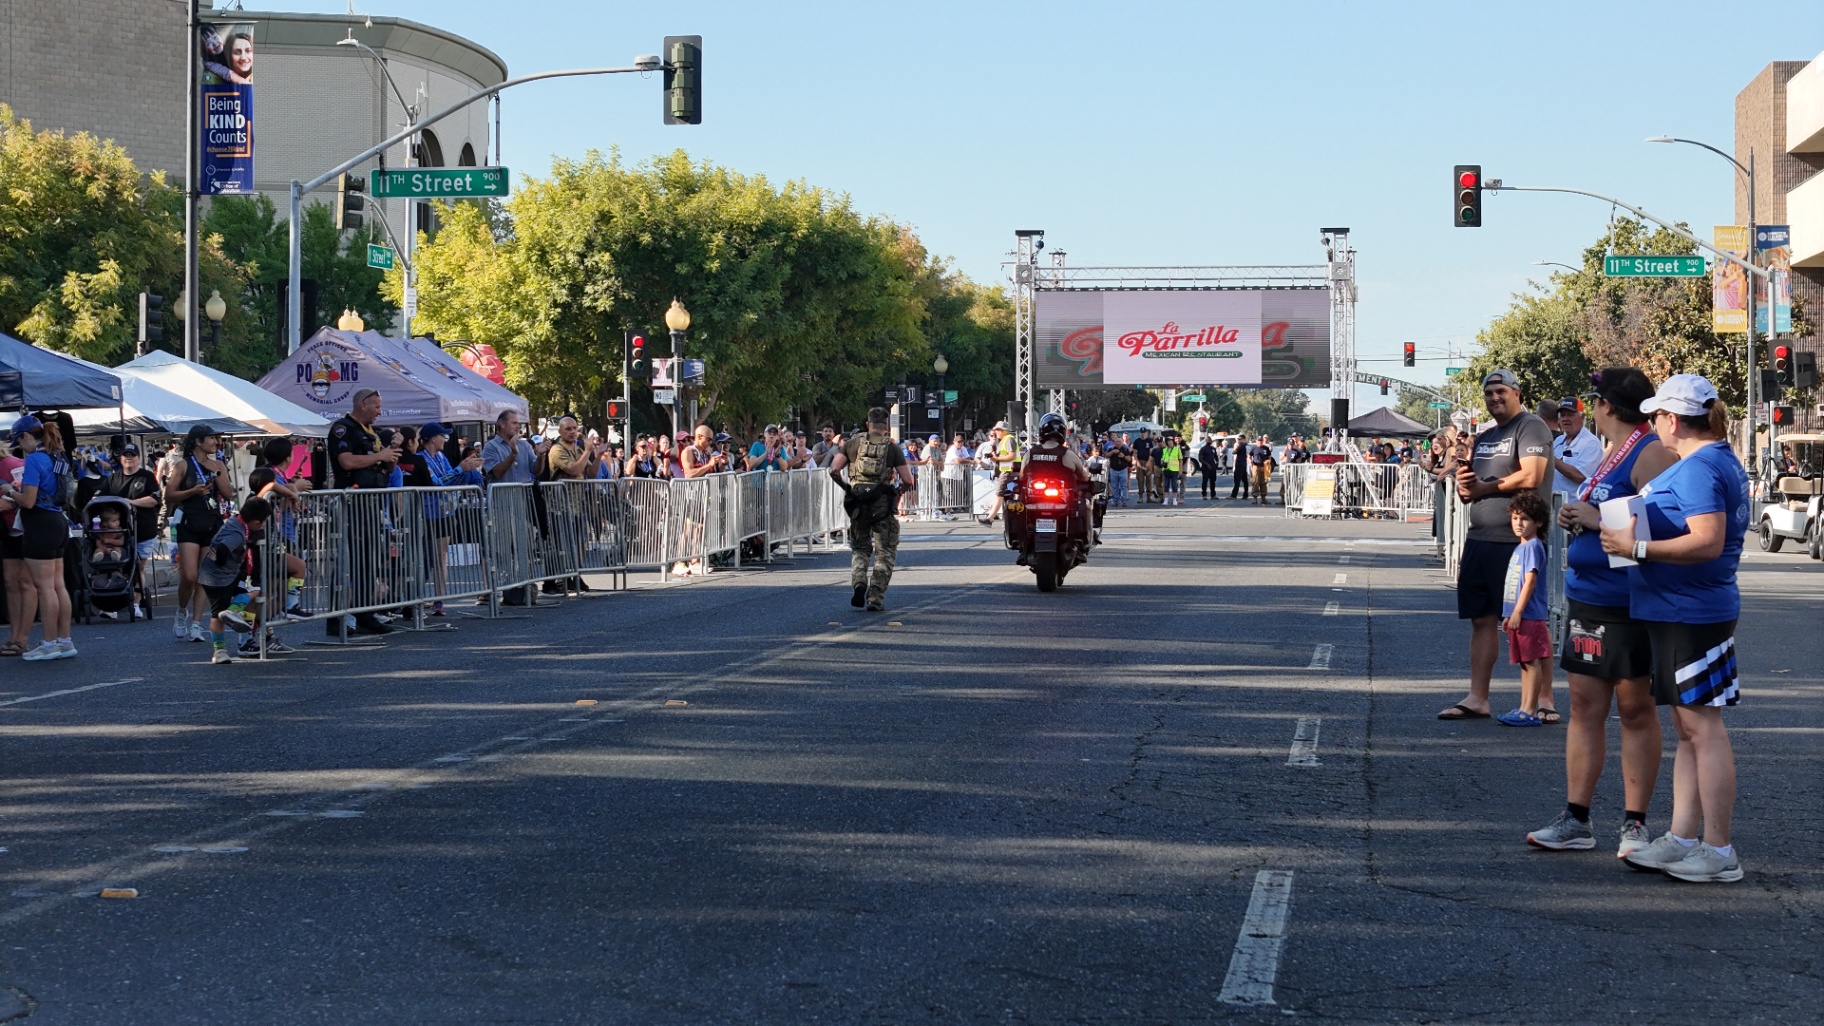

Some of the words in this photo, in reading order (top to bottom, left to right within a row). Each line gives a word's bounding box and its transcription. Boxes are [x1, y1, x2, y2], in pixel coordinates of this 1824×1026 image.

[209, 97, 241, 114] Being
[209, 114, 246, 129] KIND
[209, 130, 246, 144] Counts
[411, 172, 473, 193] Street
[482, 172, 500, 181] 900
[1609, 259, 1631, 274] 11TH
[1634, 259, 1680, 274] Street
[1156, 320, 1181, 335] La
[1117, 325, 1240, 357] Parrilla
[388, 408, 422, 417] Remember
[1613, 429, 1642, 464] FORGOTTEN
